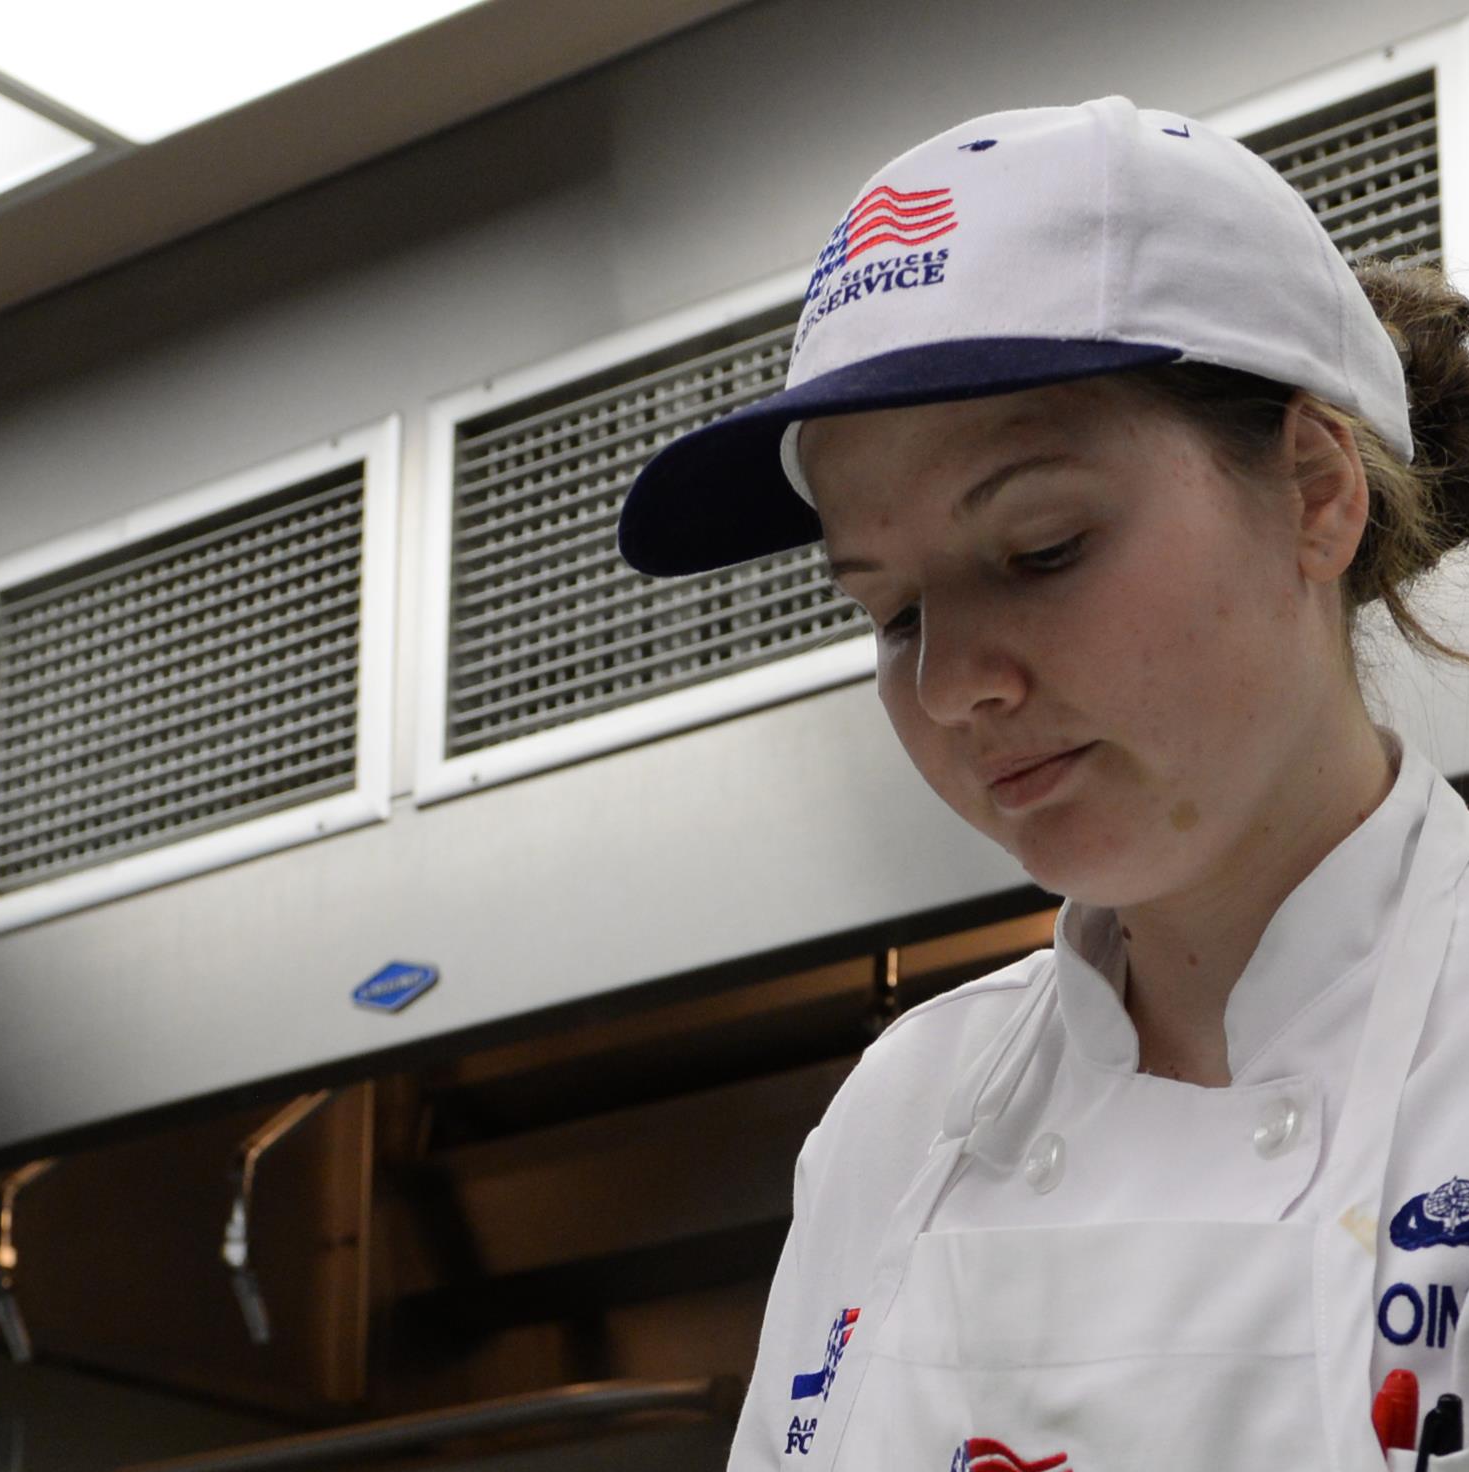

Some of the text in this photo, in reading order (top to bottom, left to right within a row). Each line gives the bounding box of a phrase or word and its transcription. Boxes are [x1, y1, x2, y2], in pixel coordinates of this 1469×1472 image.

[840, 248, 950, 287] SERVICES
[795, 262, 945, 350] SERVICE
[789, 1415, 818, 1431] AIR
